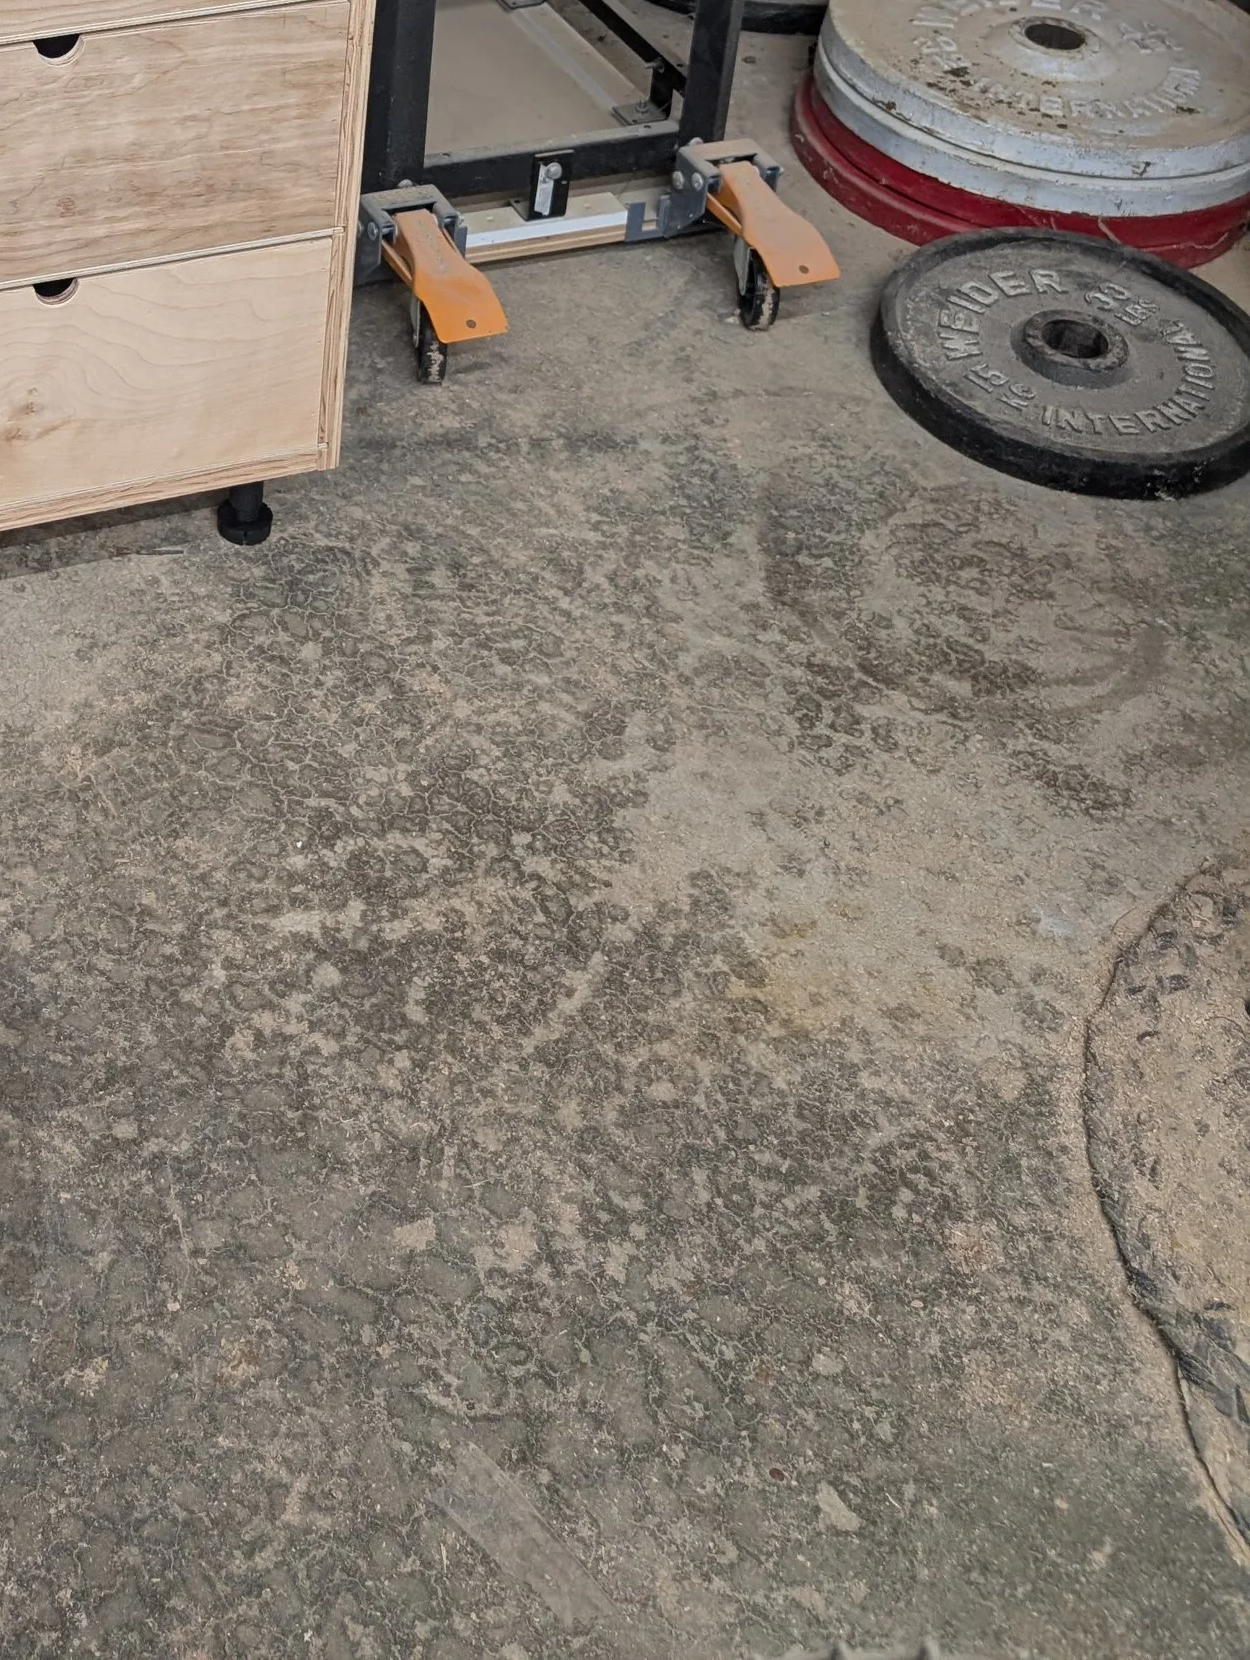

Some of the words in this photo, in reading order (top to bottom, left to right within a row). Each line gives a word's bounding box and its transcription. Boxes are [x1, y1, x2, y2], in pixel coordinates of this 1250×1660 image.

[1084, 282, 1131, 313] 33
[1114, 298, 1161, 327] LBS
[937, 268, 1068, 361] WEIDER
[964, 362, 1009, 393] 15
[1041, 317, 1217, 437] INTERNATIONAL
[996, 382, 1036, 412] KG
